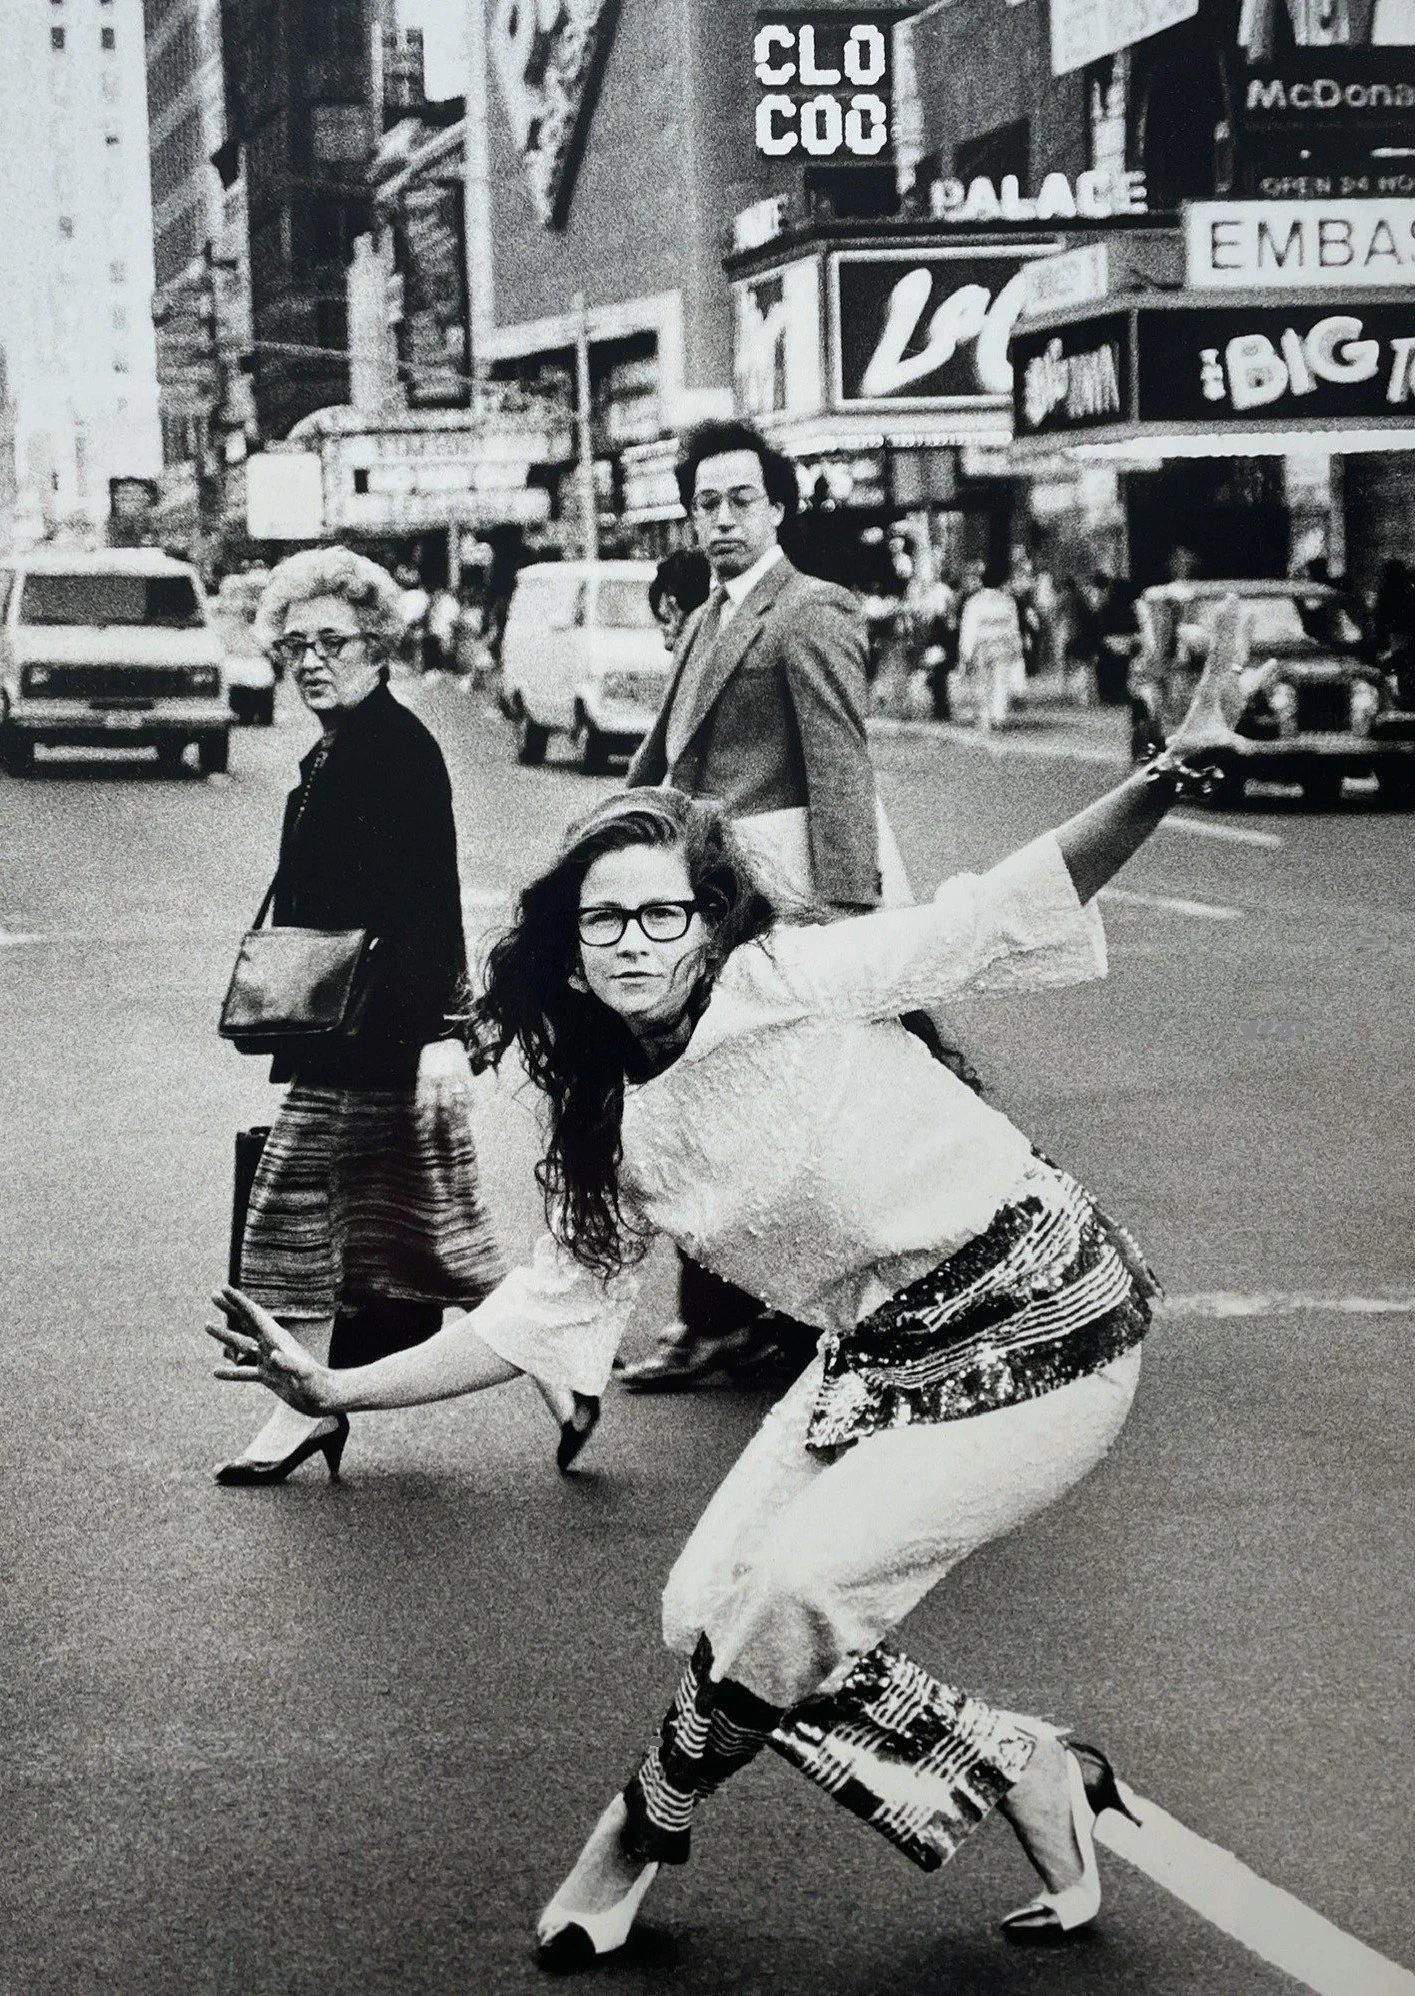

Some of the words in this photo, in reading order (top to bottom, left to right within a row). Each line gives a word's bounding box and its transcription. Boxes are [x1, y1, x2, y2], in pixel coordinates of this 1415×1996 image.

[754, 24, 886, 86] CLO
[929, 171, 1149, 222] PALACE
[1210, 219, 1415, 268] EMBA
[1226, 315, 1380, 411] BIG
